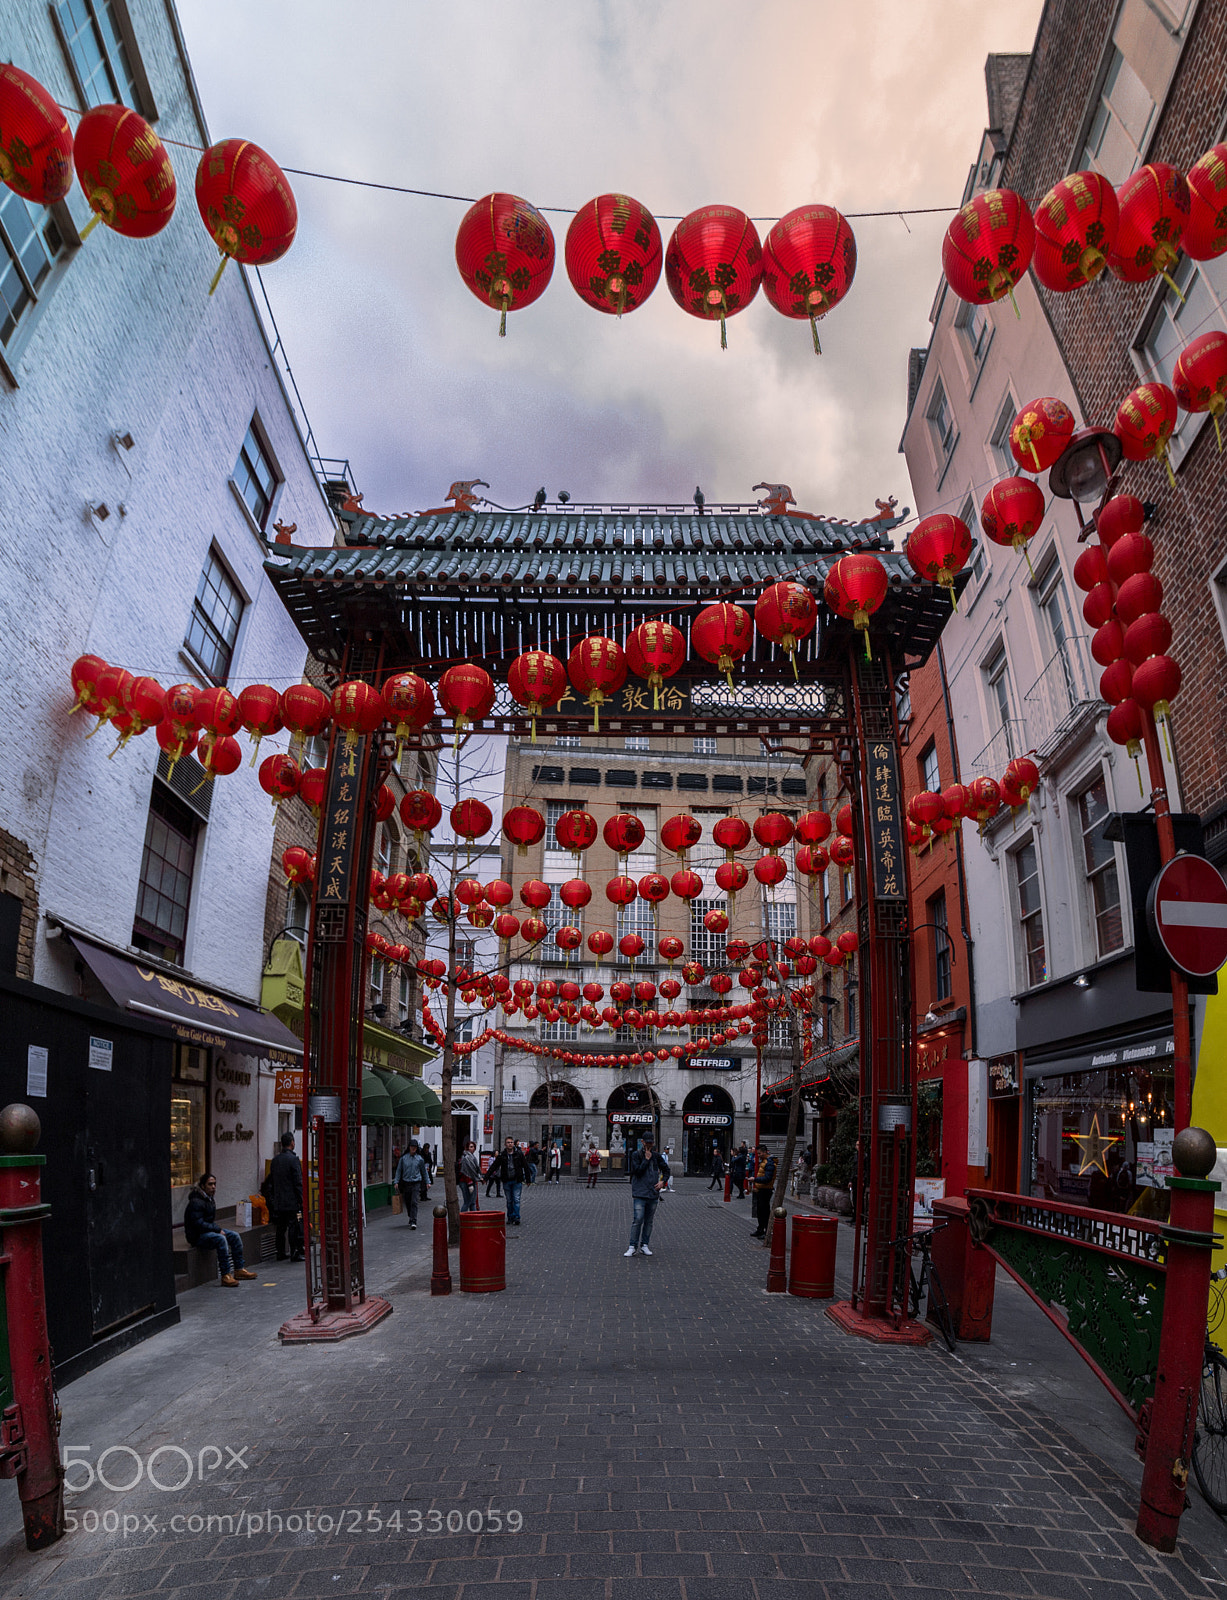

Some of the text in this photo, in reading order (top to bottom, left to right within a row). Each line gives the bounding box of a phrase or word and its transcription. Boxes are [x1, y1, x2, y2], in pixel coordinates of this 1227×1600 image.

[1091, 1052, 1117, 1066] Authentic
[1122, 1045, 1156, 1060] Vietnamese
[689, 1058, 731, 1067] BETFRED
[612, 1114, 653, 1122] BETFRED
[688, 1115, 729, 1124] BETFRED
